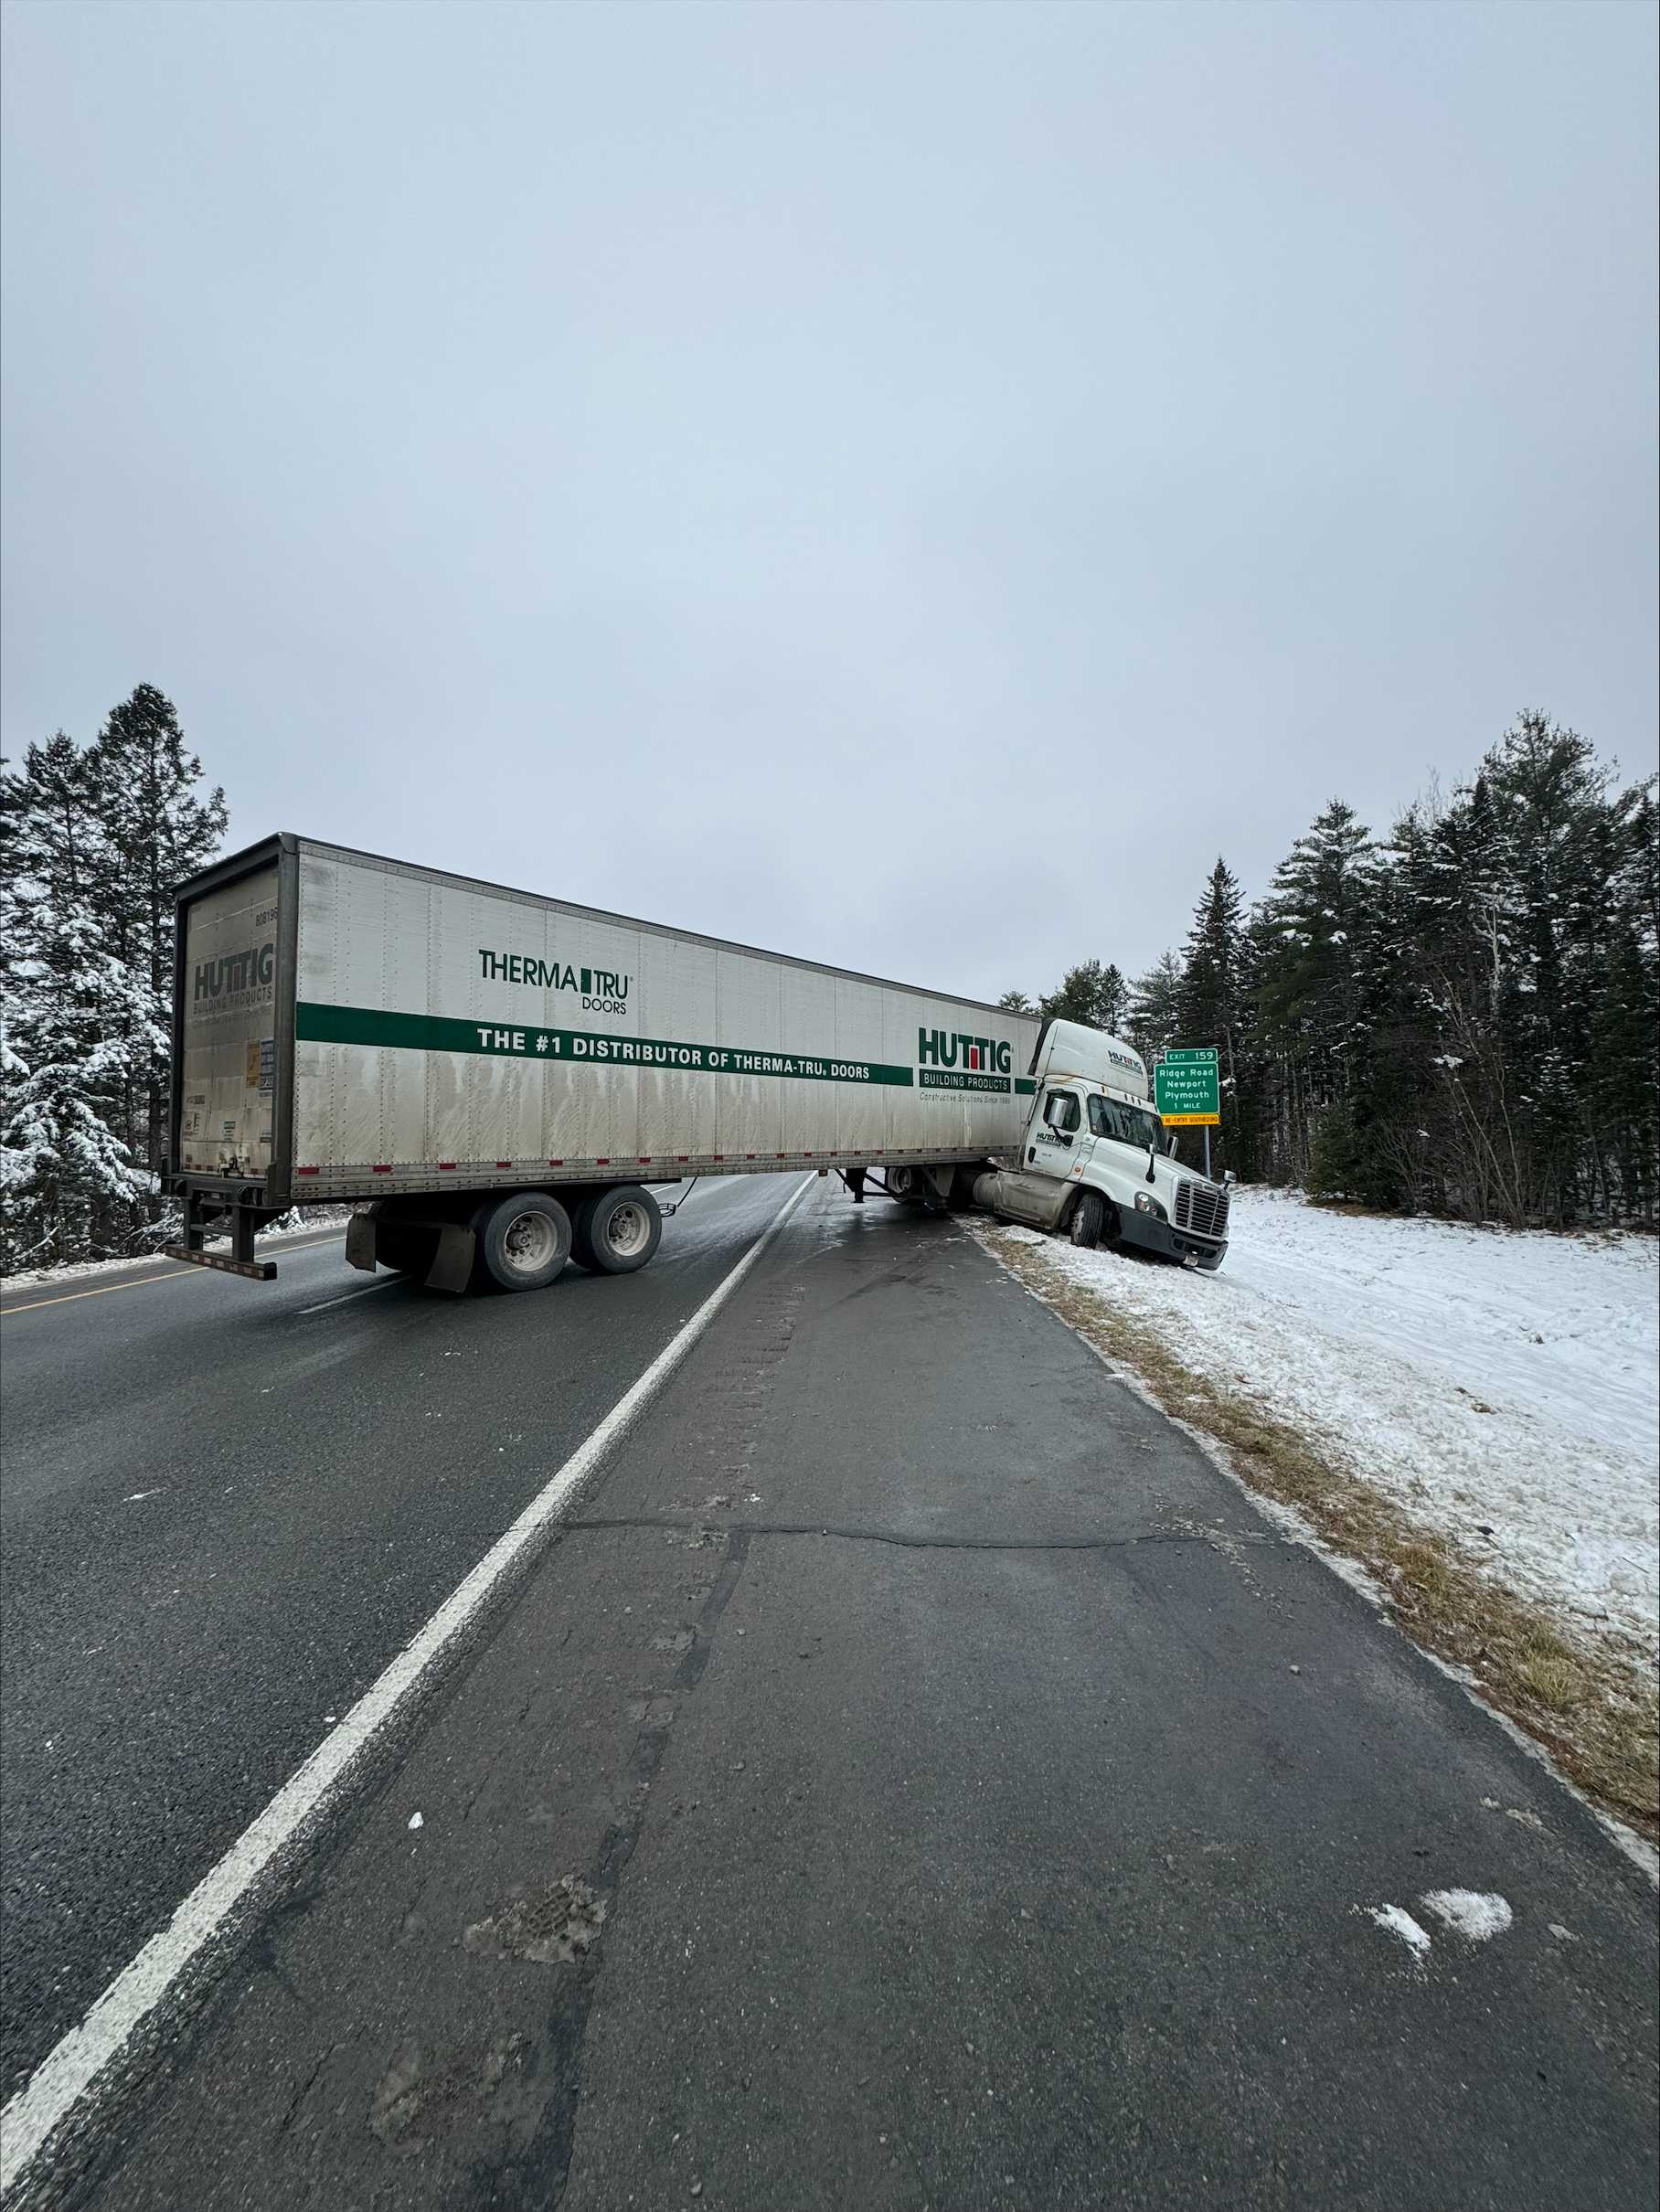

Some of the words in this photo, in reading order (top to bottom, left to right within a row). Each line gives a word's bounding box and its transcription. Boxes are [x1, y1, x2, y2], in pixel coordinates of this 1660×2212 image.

[195, 942, 273, 1000] HUTTIG
[478, 949, 578, 992] THERMA
[593, 970, 628, 999] TRU
[582, 996, 626, 1015] DOORS
[477, 1028, 526, 1050] THE
[536, 1035, 560, 1053] #1
[572, 1037, 702, 1065] DISTRIBUTOR
[708, 1051, 729, 1067] OF
[831, 1064, 869, 1079] DOORS
[919, 1027, 1011, 1074] HUTTIG
[1195, 1051, 1214, 1060] 159
[924, 1073, 964, 1087] BUILDING
[968, 1078, 1007, 1090] PRODUCTS
[1159, 1069, 1186, 1078] Ridge
[1189, 1069, 1214, 1077] Road
[1166, 1080, 1207, 1090] Newport
[1165, 1091, 1209, 1101] Plymouth
